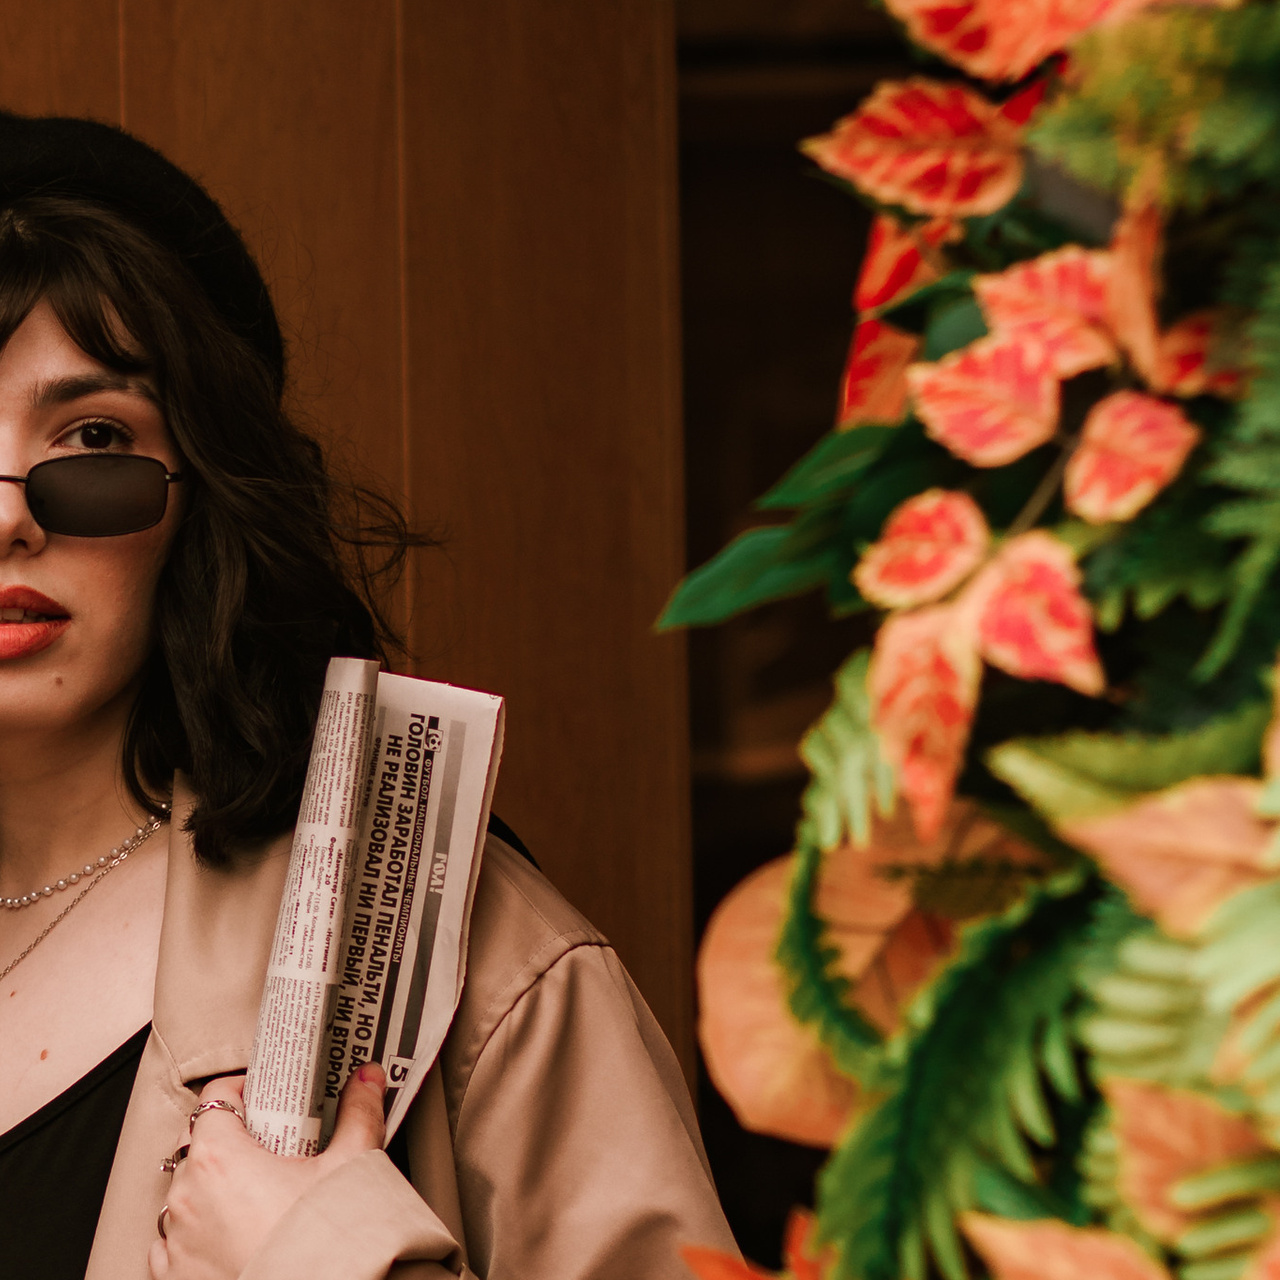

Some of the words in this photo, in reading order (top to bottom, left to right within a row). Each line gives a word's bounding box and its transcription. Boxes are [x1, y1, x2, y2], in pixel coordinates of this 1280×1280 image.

[386, 734, 403, 757] НЕ
[400, 713, 426, 800] ГОЛОВИН
[418, 759, 432, 802] ФУТБОЛ.
[363, 761, 399, 878] РЕАЛИЗОВАЛ
[328, 837, 336, 868] Форест»
[380, 803, 413, 908] ЗАРАБОТАЛ
[404, 803, 426, 889] НАЦИОНАЛЬНЫЕ
[331, 849, 343, 894] «Манчестер
[429, 852, 447, 894] ГОЛ!
[357, 882, 377, 909] НИ
[392, 890, 412, 962] ЧЕМПИОНАТЫ
[322, 928, 332, 972] «Ноттингем
[337, 913, 372, 990] ПЕРВЫЙ,
[358, 911, 394, 1008] ПЕНАЛЬТИ,
[334, 995, 355, 1022] НИ
[355, 1013, 374, 1040] НО
[324, 1026, 349, 1100] ВТОРОЙ
[390, 1064, 408, 1082] 5
